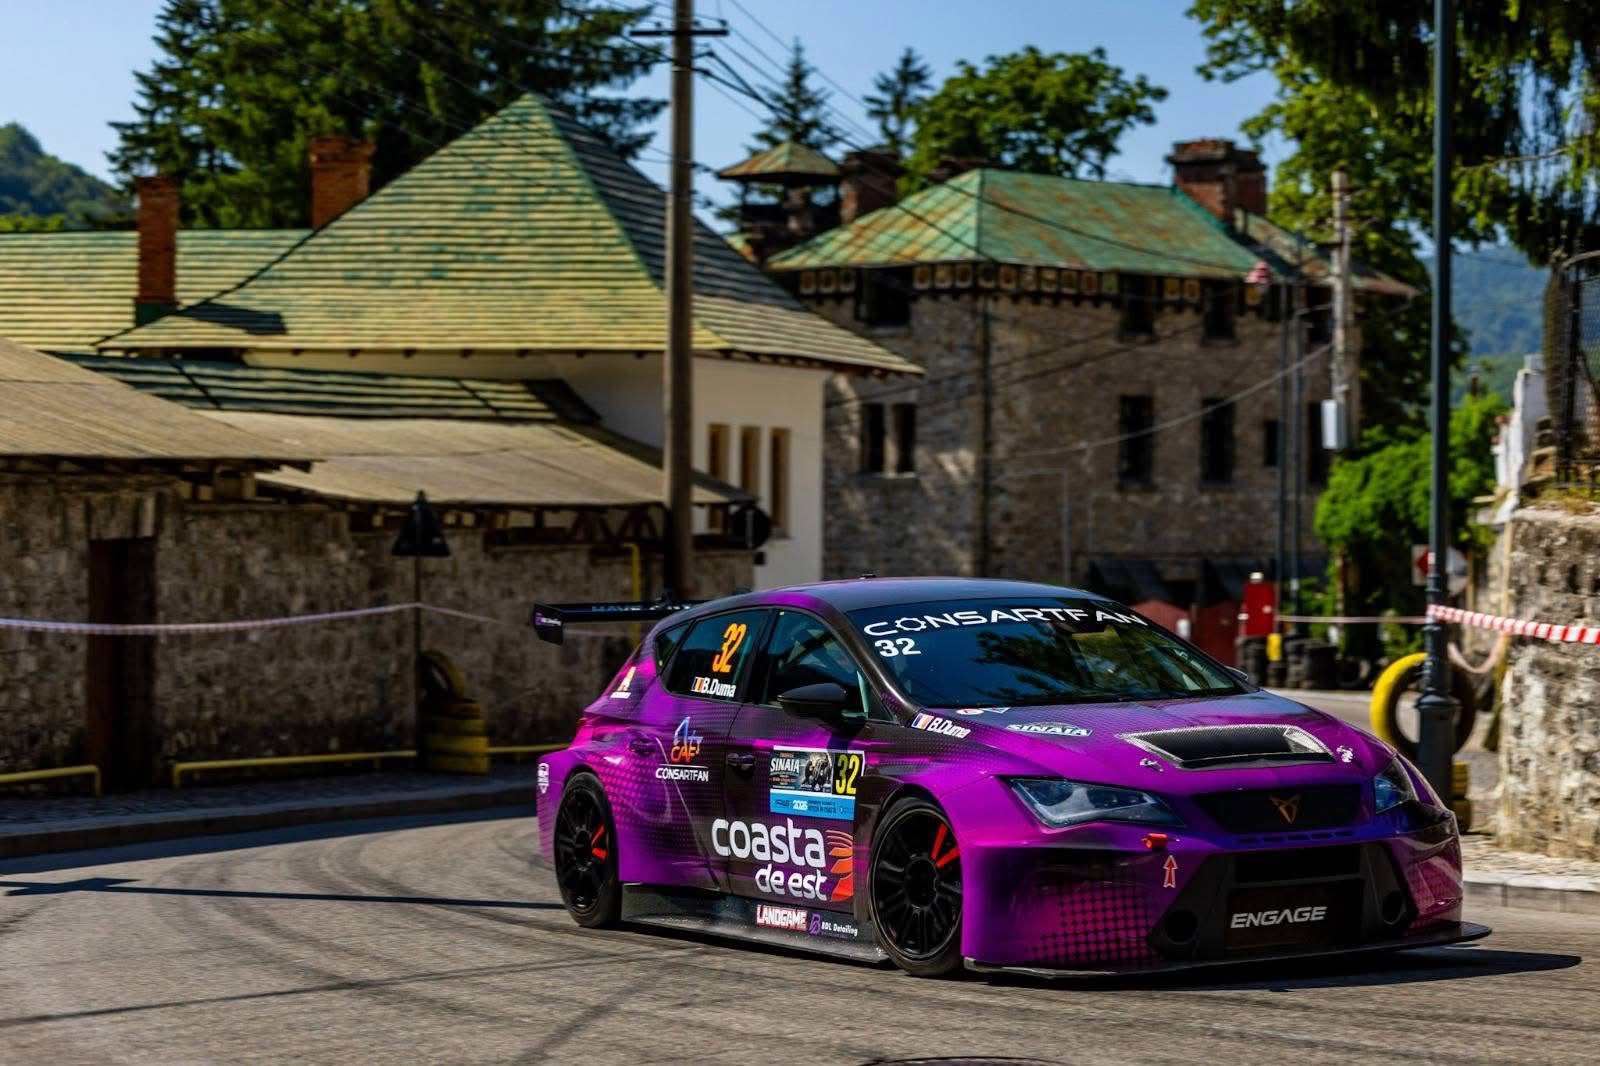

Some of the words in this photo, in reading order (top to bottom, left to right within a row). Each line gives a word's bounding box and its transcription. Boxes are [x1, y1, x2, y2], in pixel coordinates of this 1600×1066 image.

[863, 608, 1148, 636] CONSARTFAN
[712, 623, 747, 673] 32
[874, 638, 922, 658] 32
[701, 677, 737, 697] B.Duma
[926, 717, 971, 739] B.Duma
[1005, 724, 1091, 737] SINAIA
[655, 768, 709, 782] CONSARTFAN
[769, 757, 800, 774] SINAIA
[835, 753, 861, 795] 32
[711, 817, 826, 868] coasta
[755, 863, 786, 895] de
[787, 869, 828, 901] est
[756, 904, 808, 932] LANDGAME
[1230, 906, 1328, 929] ENGAGE
[833, 923, 858, 937] Detailing
